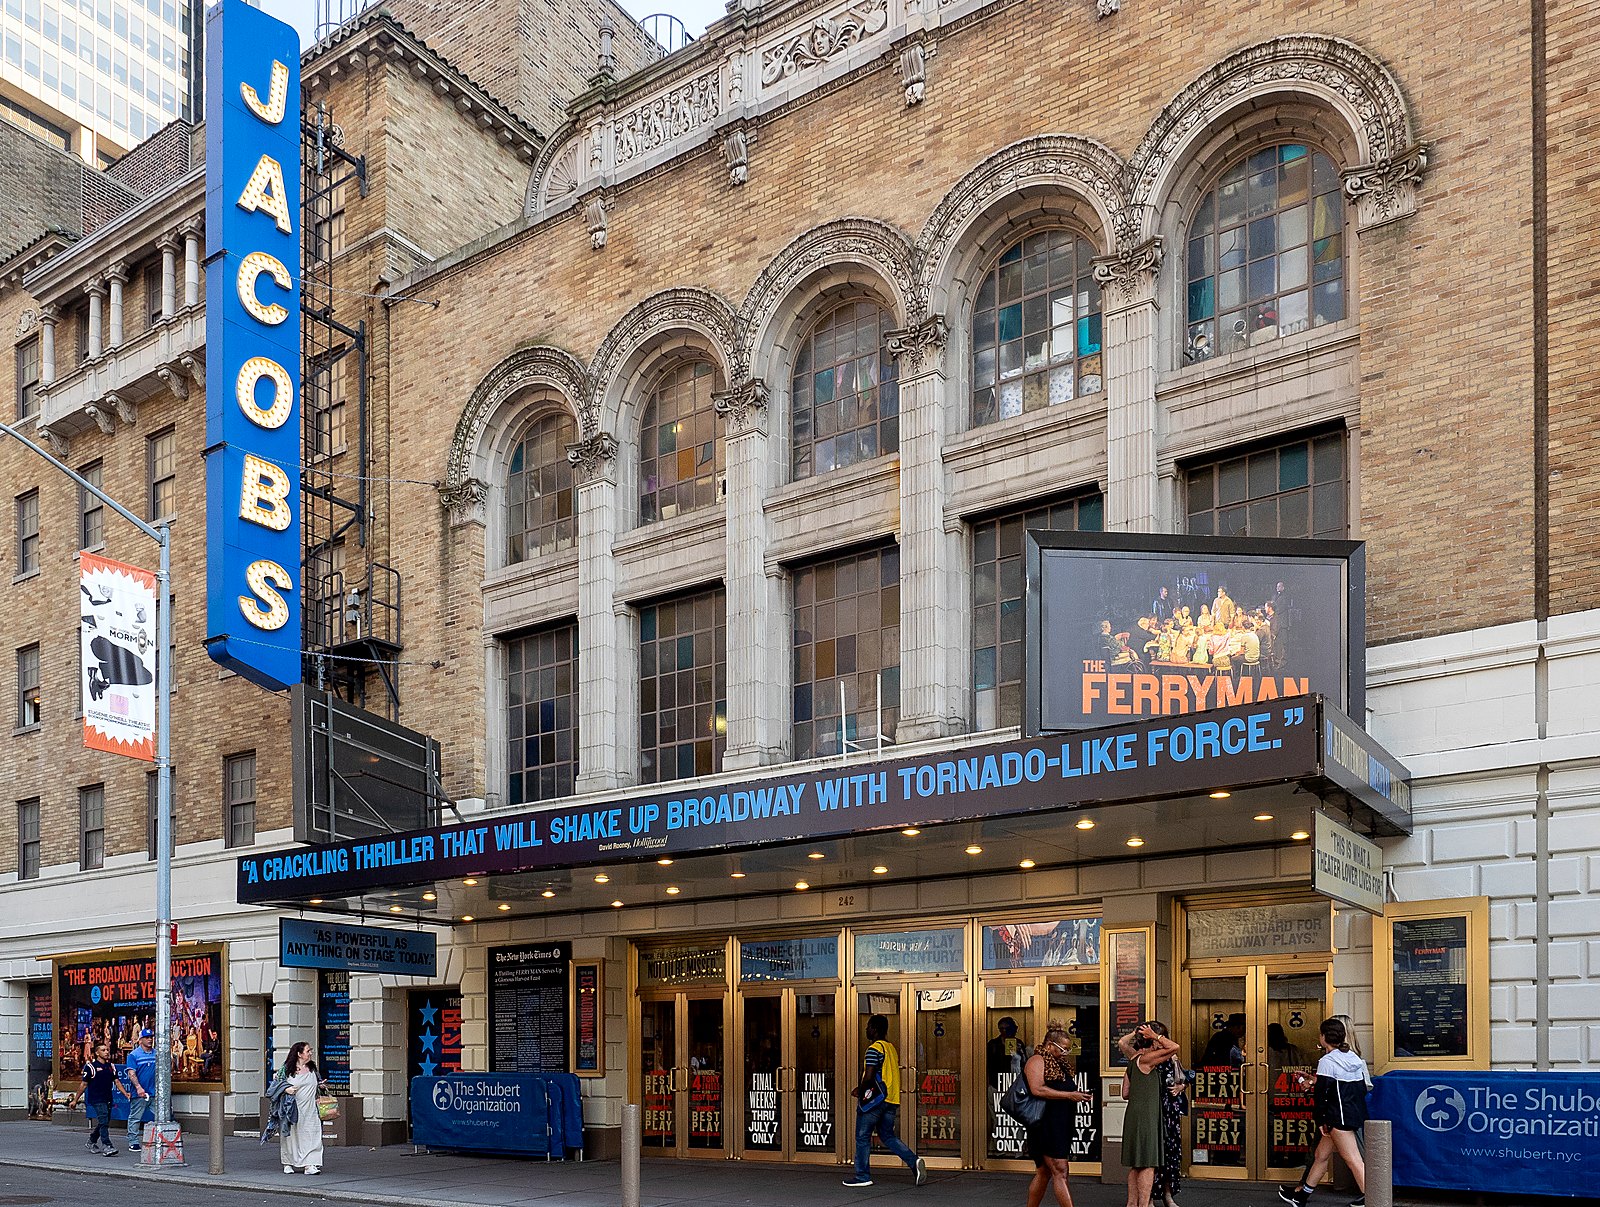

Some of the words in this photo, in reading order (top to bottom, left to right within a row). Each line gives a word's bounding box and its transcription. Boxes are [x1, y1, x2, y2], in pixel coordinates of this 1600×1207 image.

[236, 58, 293, 631] JACOBS
[1083, 660, 1105, 672] THE
[263, 849, 348, 880] CRACKLING
[355, 836, 434, 868] THRILLER
[440, 828, 488, 858] THAT
[494, 821, 543, 851] WILL
[550, 809, 622, 845] SHAKE
[629, 804, 660, 832] UP
[667, 783, 806, 830] BROADWAY
[815, 771, 887, 811] WITH
[897, 733, 1137, 801] TORNADO-LIKE
[598, 842, 612, 851] David
[1346, 840, 1352, 859] IS
[1352, 842, 1366, 867] WHAT
[1367, 852, 1370, 869] A
[1317, 848, 1340, 880] THEATER
[1342, 862, 1358, 886] LOVER
[1359, 870, 1372, 892] LIVES
[838, 896, 854, 906] 242
[1228, 920, 1292, 936] STANDARD
[1297, 918, 1322, 931] FOR
[336, 932, 390, 948] POWERFUL
[394, 937, 408, 950] AS
[1202, 934, 1270, 950] BROADWAY
[287, 942, 342, 958] ANYTHING
[346, 947, 360, 960] ON
[364, 950, 396, 962] STAGE
[496, 953, 506, 962] The
[507, 952, 519, 961] New
[520, 951, 534, 962] York
[534, 950, 552, 959] Times
[89, 964, 142, 984] BROADWAY
[146, 958, 210, 980] PRUCTION
[102, 984, 114, 1000] OF
[118, 984, 138, 1000] THE
[646, 1075, 671, 1084] BEST
[692, 1075, 700, 1090] 4
[752, 1073, 774, 1090] FINAL
[804, 1074, 826, 1091] FINAL
[922, 1075, 932, 1092] 4
[1196, 1072, 1240, 1084] BEST
[1274, 1073, 1288, 1092] 4
[454, 1082, 474, 1096] The
[476, 1082, 520, 1097] Shubert
[646, 1085, 671, 1094] PLAY
[1196, 1085, 1240, 1098] PLAY
[750, 1091, 776, 1109] WEEKS!
[802, 1092, 830, 1110] WEEKS!
[922, 1096, 938, 1104] BEST
[940, 1096, 955, 1104] PLAY
[1274, 1098, 1296, 1106] BEST
[1298, 1098, 1314, 1106] PLA
[1468, 1087, 1518, 1110] The
[454, 1097, 520, 1114] Organization
[646, 1111, 672, 1120] BEST
[692, 1112, 720, 1122] BEST
[752, 1110, 774, 1121] THRU
[804, 1112, 828, 1122] THRU
[452, 1119, 500, 1128] www.shubert.nyc
[646, 1121, 672, 1130] PLAY
[692, 1122, 720, 1132] PLAY
[748, 1122, 770, 1132] JULY
[772, 1122, 778, 1132] 7
[922, 1116, 955, 1128] BEST
[1196, 1118, 1240, 1131] BEST
[800, 1123, 822, 1134] JULY
[825, 1123, 832, 1134] 7
[922, 1128, 955, 1139] PLAY
[992, 1128, 1018, 1139] JULY
[752, 1133, 774, 1144] ONLY
[804, 1134, 828, 1146] ONLY
[1089, 1129, 1096, 1141] 7
[1196, 1132, 1240, 1144] PLAY
[996, 1140, 1024, 1152] ONLY
[1460, 1147, 1582, 1163] www.shubert.nyc
